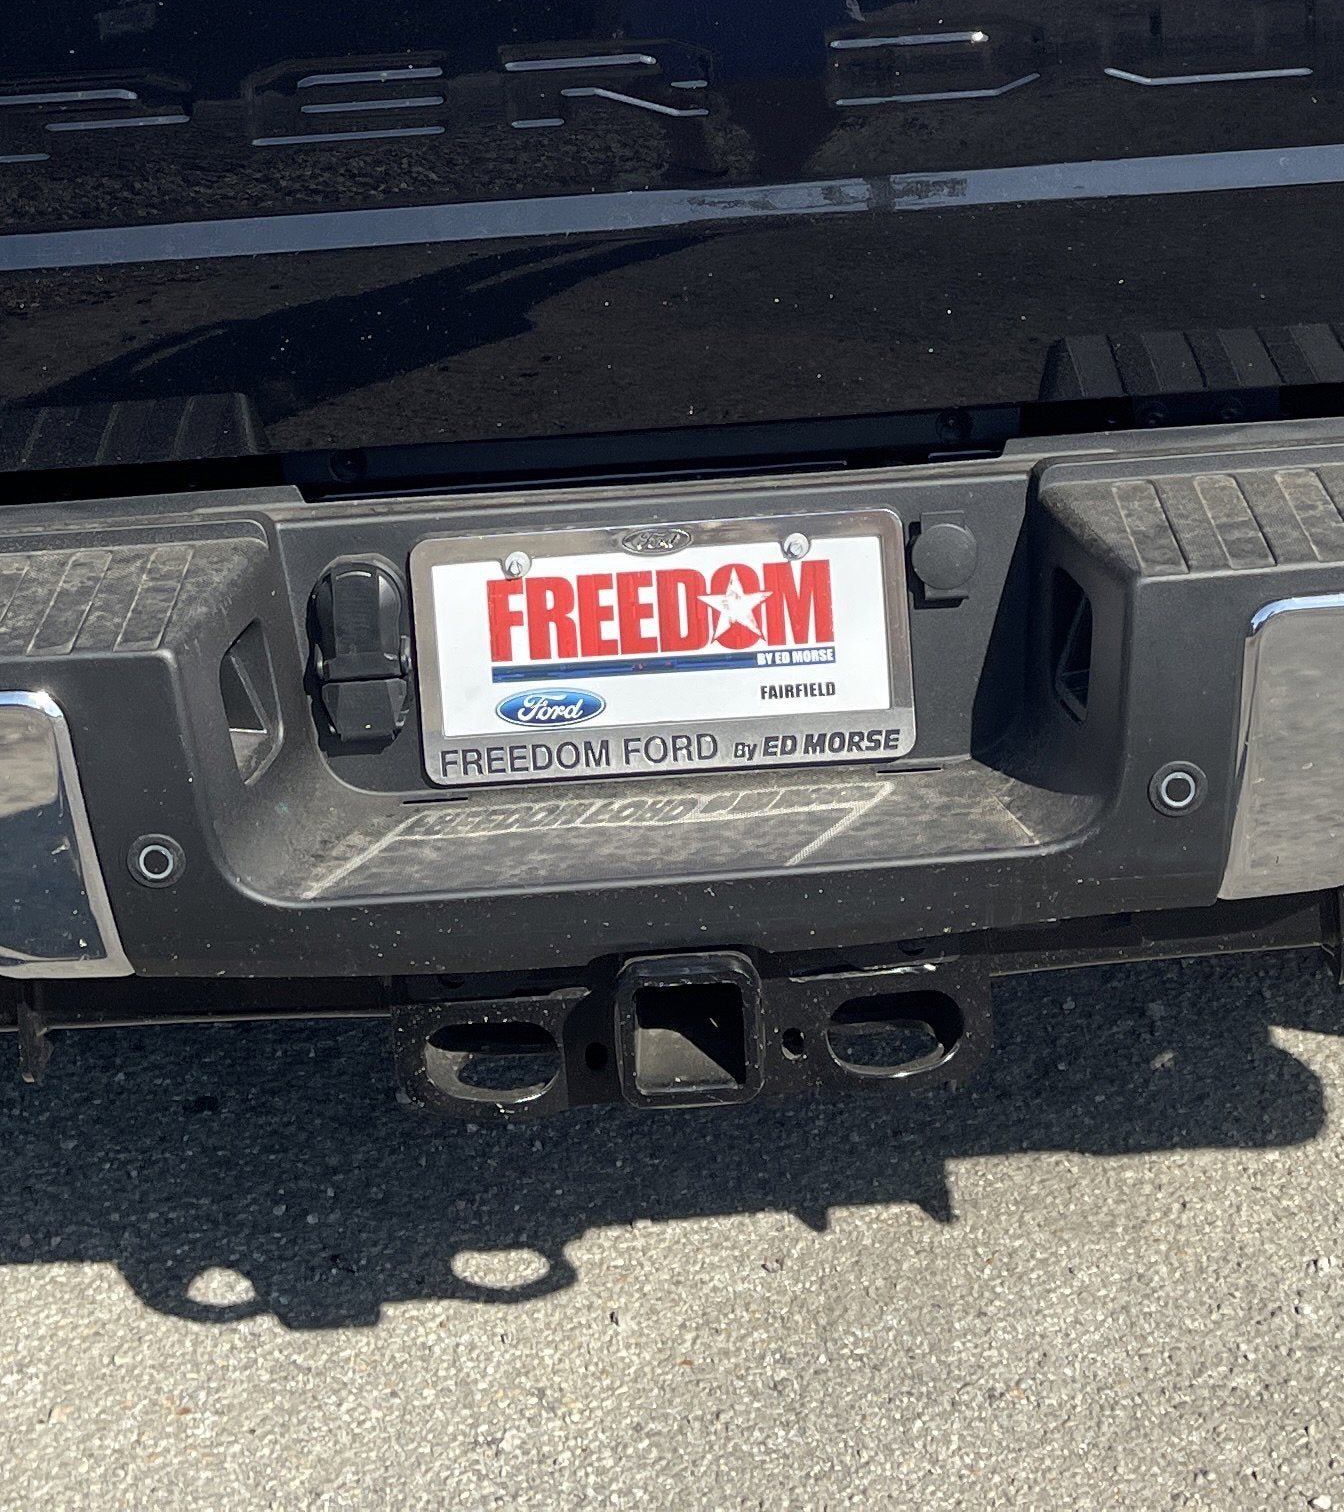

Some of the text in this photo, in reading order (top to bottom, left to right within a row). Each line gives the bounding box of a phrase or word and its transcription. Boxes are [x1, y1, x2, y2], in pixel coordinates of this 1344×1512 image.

[486, 560, 836, 663] FREEDOM
[756, 648, 835, 666] BY ED MORSE
[760, 681, 836, 700] FAIRFIELD
[517, 692, 584, 722] Ford
[440, 738, 611, 778] FREEDOM
[623, 732, 719, 766] FORD
[762, 734, 798, 758] ED
[803, 728, 901, 755] MORSE
